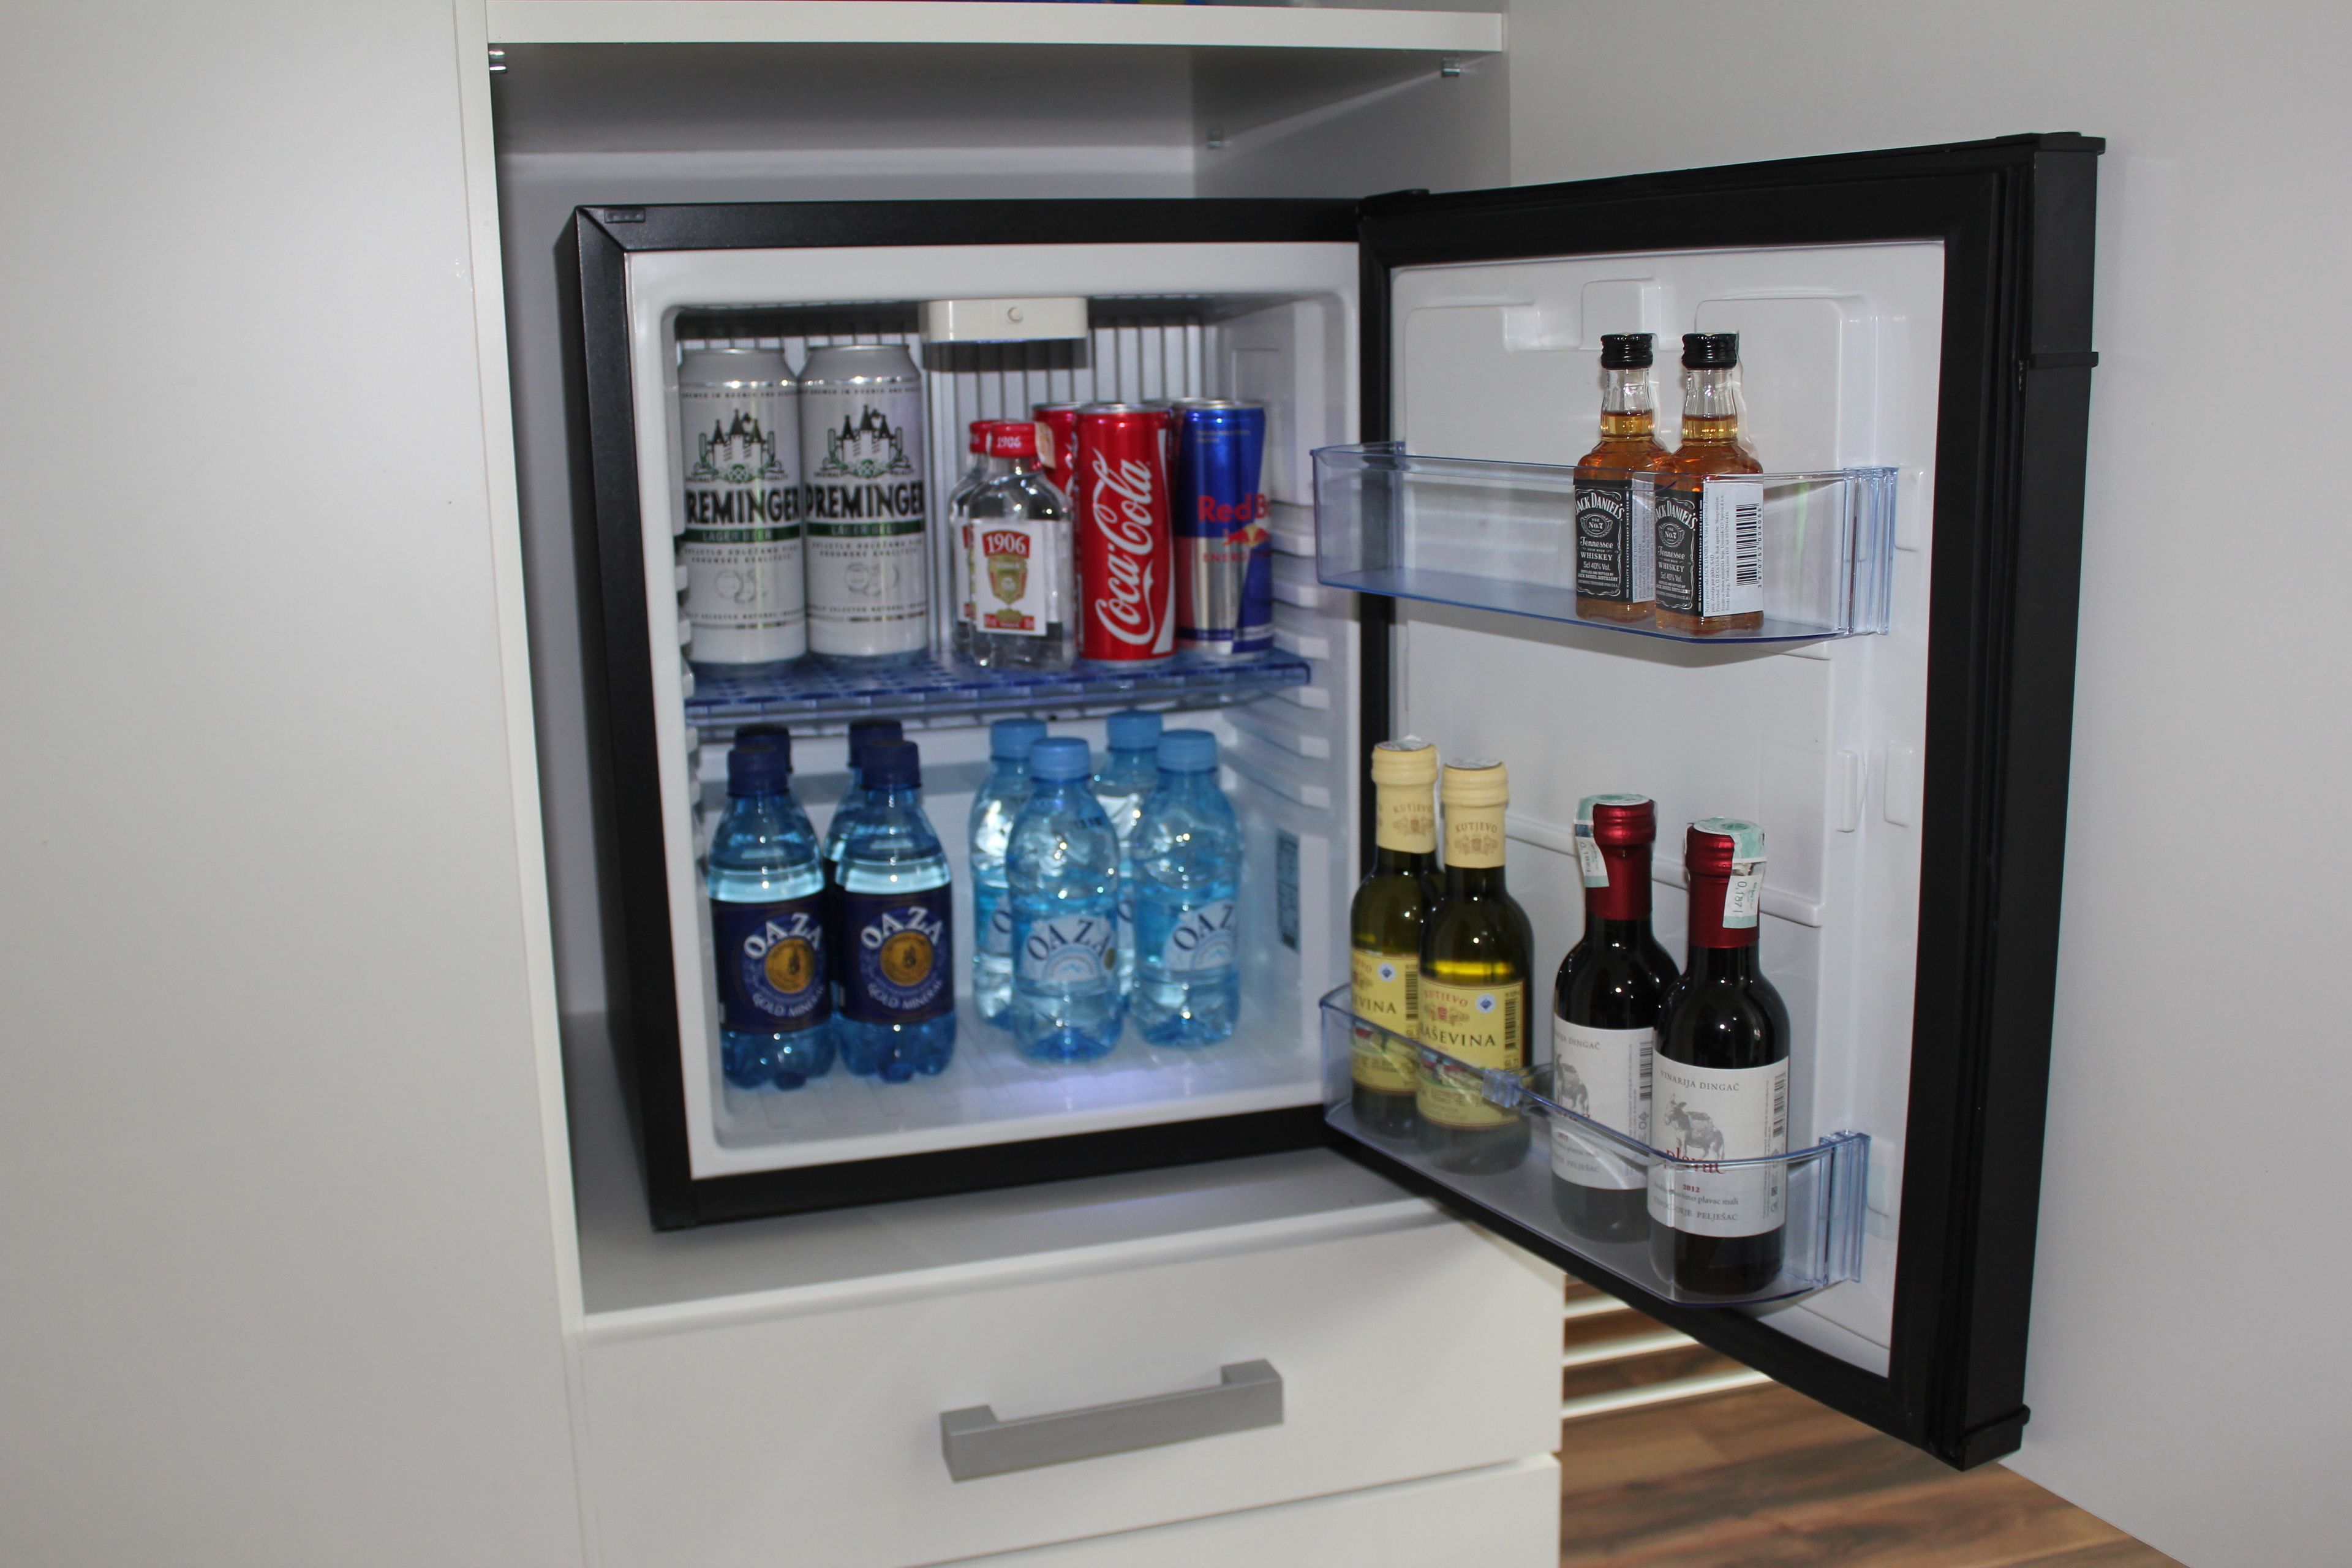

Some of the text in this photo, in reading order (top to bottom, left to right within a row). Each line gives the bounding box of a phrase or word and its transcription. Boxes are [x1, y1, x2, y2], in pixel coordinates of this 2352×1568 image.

[997, 435, 1022, 448] 1906
[805, 480, 925, 519] PREMINGE
[1198, 493, 1251, 522] Red
[1575, 492, 1625, 519] JACK DANIEL'S
[1667, 500, 1698, 529] DANIEL'S
[986, 533, 1027, 555] 1906
[1091, 447, 1156, 646] Coca-Cola
[1580, 536, 1614, 549] Tennessee
[1657, 546, 1686, 560] Tennessee
[1580, 551, 1613, 561] WHISKEY
[1658, 561, 1684, 573] WHISKEY
[1455, 821, 1498, 833] KUTJEVO
[1734, 881, 1747, 908] 0,187
[744, 912, 823, 960] OAZA
[861, 906, 943, 949] OAZA
[1173, 904, 1236, 951] OAZ
[1027, 919, 1111, 960] OAZA
[1569, 1037, 1601, 1050] DINGAČ
[1660, 1069, 1740, 1091] VINARIJA DINGAČ
[1683, 1184, 1701, 1193] 2012
[1697, 1196, 1721, 1205] plavac
[1697, 1212, 1738, 1221] PELJEŠAC
